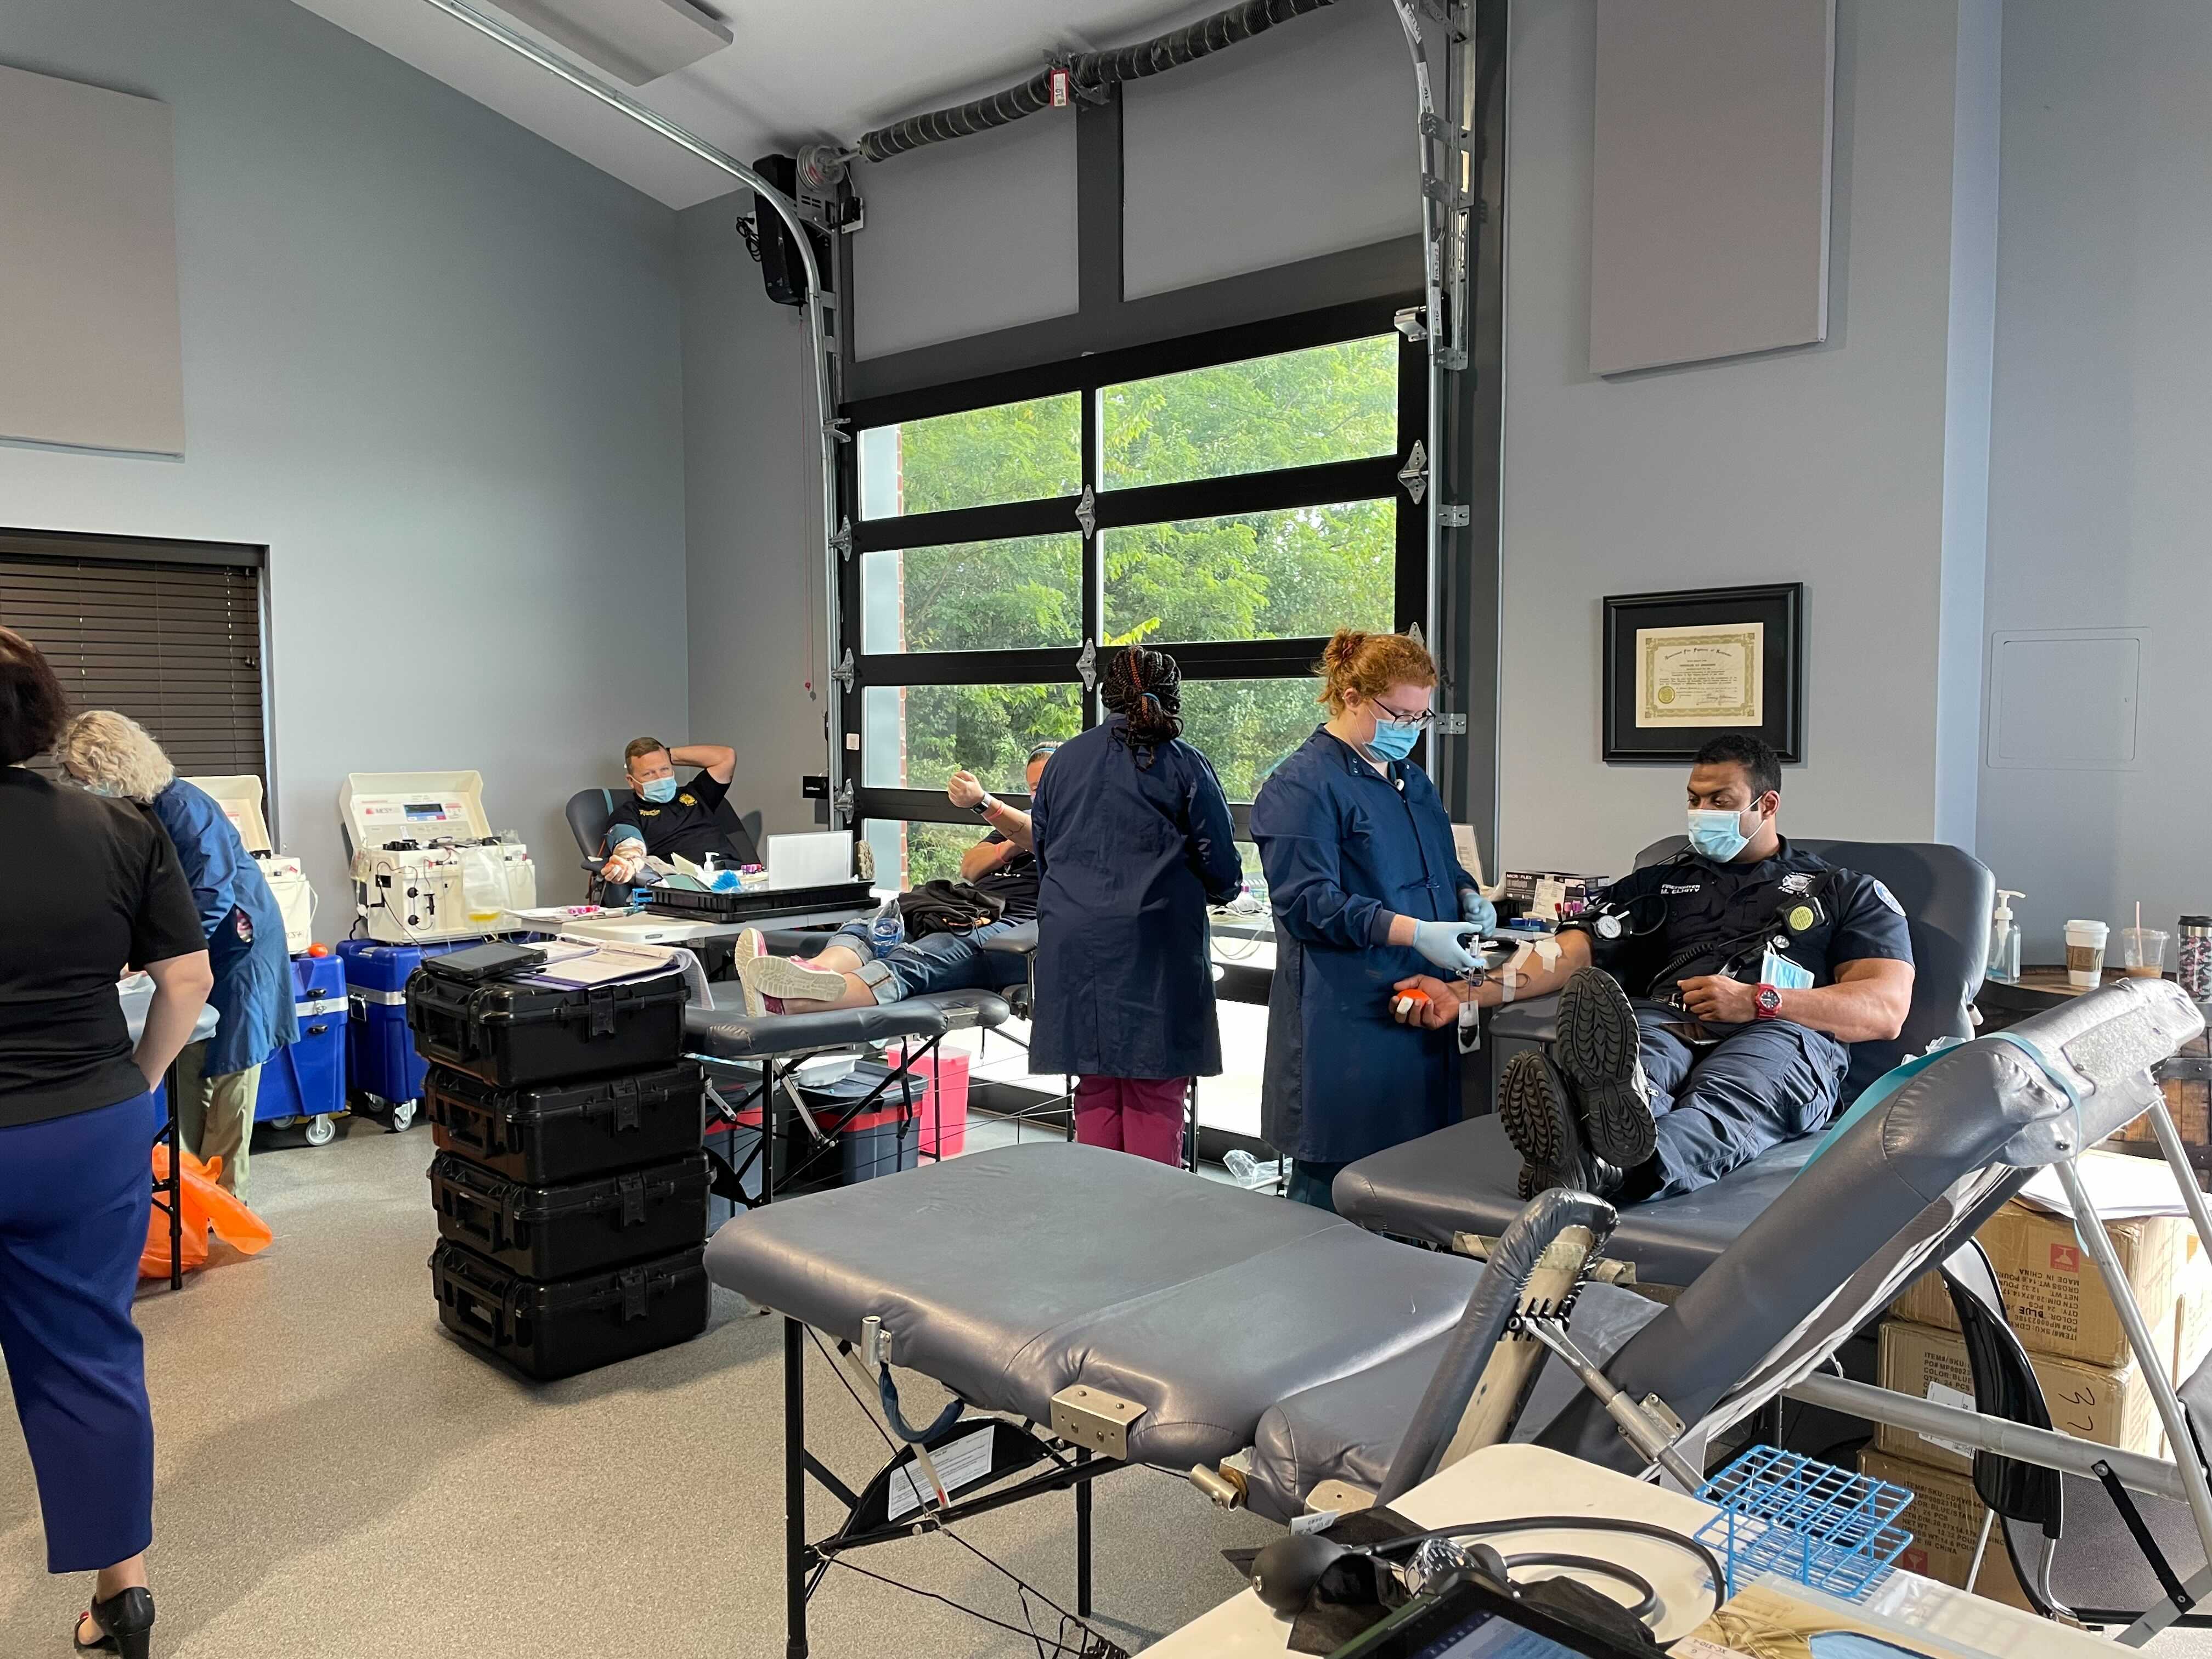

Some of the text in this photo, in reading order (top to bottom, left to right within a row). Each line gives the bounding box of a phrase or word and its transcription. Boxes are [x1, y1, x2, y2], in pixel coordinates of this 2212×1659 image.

[285, 931, 303, 939] CS+
[2019, 1268, 2042, 1278] CHINA
[2058, 1277, 2079, 1286] MADE
[2052, 1283, 2079, 1294] GROSS
[2029, 1301, 2044, 1310] PCS
[2019, 1306, 2044, 1318] BLUE
[2063, 1325, 2077, 1333] PO#
[1955, 1382, 1970, 1391] PCS
[1903, 1511, 1916, 1520] CTN
[1934, 1513, 1948, 1521] PCS
[1902, 1519, 1916, 1527] NET
[1935, 1543, 1957, 1555] CHINA
